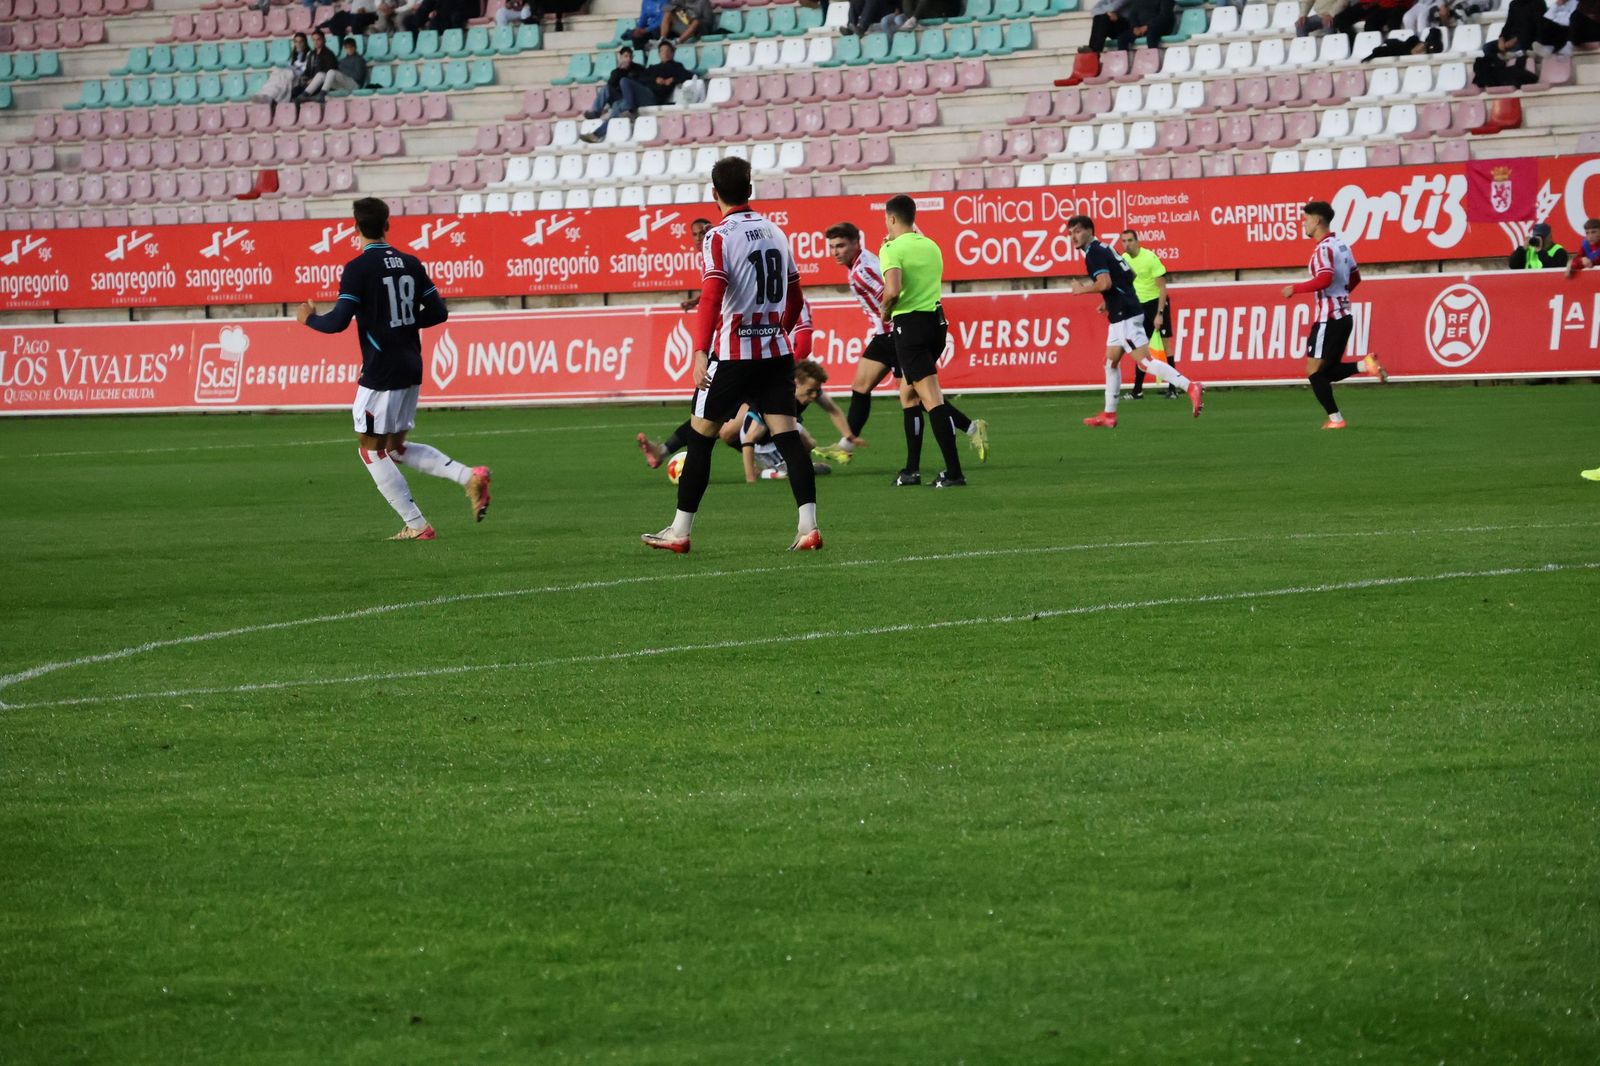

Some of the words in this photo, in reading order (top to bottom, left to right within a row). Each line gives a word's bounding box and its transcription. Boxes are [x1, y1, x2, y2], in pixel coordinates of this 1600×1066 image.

[953, 194, 1034, 225] Clínica
[1041, 188, 1121, 221] Dental
[1178, 192, 1189, 204] de
[1127, 212, 1157, 226] Sangre
[1170, 209, 1192, 222] Local
[1193, 209, 1200, 222] A
[450, 231, 466, 246] sgc
[565, 227, 581, 242] sgc
[670, 222, 686, 238] sgc
[1247, 221, 1297, 242] HIJOS
[144, 243, 159, 258] sgc
[240, 239, 255, 254] sgc
[350, 236, 361, 250] sg
[39, 247, 52, 262] sgc
[294, 263, 342, 289] sangre
[506, 249, 600, 283] sangregorio
[747, 248, 784, 304] 18
[0, 269, 69, 299] ngregorio
[90, 264, 176, 296] sangregorio
[185, 262, 273, 293] sangregorio
[382, 274, 416, 328] 18
[959, 317, 1071, 350] VERSUS
[467, 339, 559, 376] INNOVA
[565, 337, 634, 381] Chef
[969, 351, 1058, 367] E-LEARNING
[201, 360, 238, 388] Susi
[121, 387, 155, 400] CRUDA
